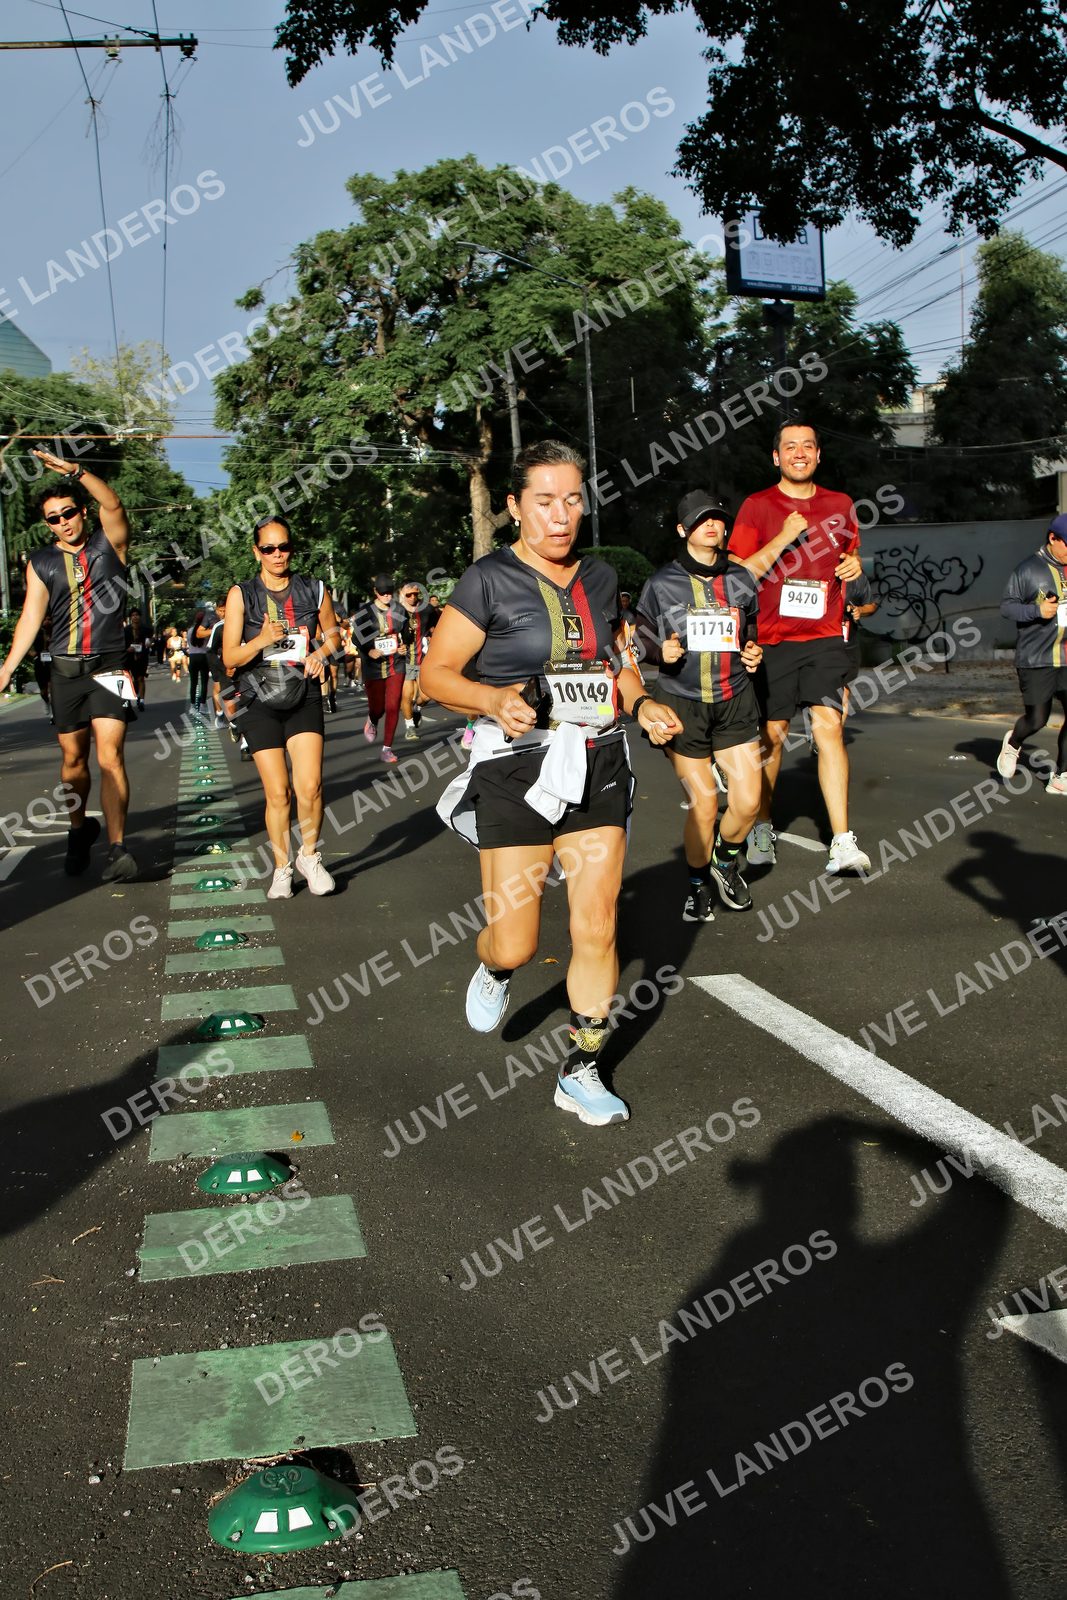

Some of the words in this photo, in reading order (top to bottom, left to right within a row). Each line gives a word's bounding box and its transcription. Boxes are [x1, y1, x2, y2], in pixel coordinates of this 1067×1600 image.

[874, 544, 919, 560] TOY
[787, 590, 818, 605] 9470
[690, 621, 734, 636] 11714
[553, 681, 609, 703] 10149
